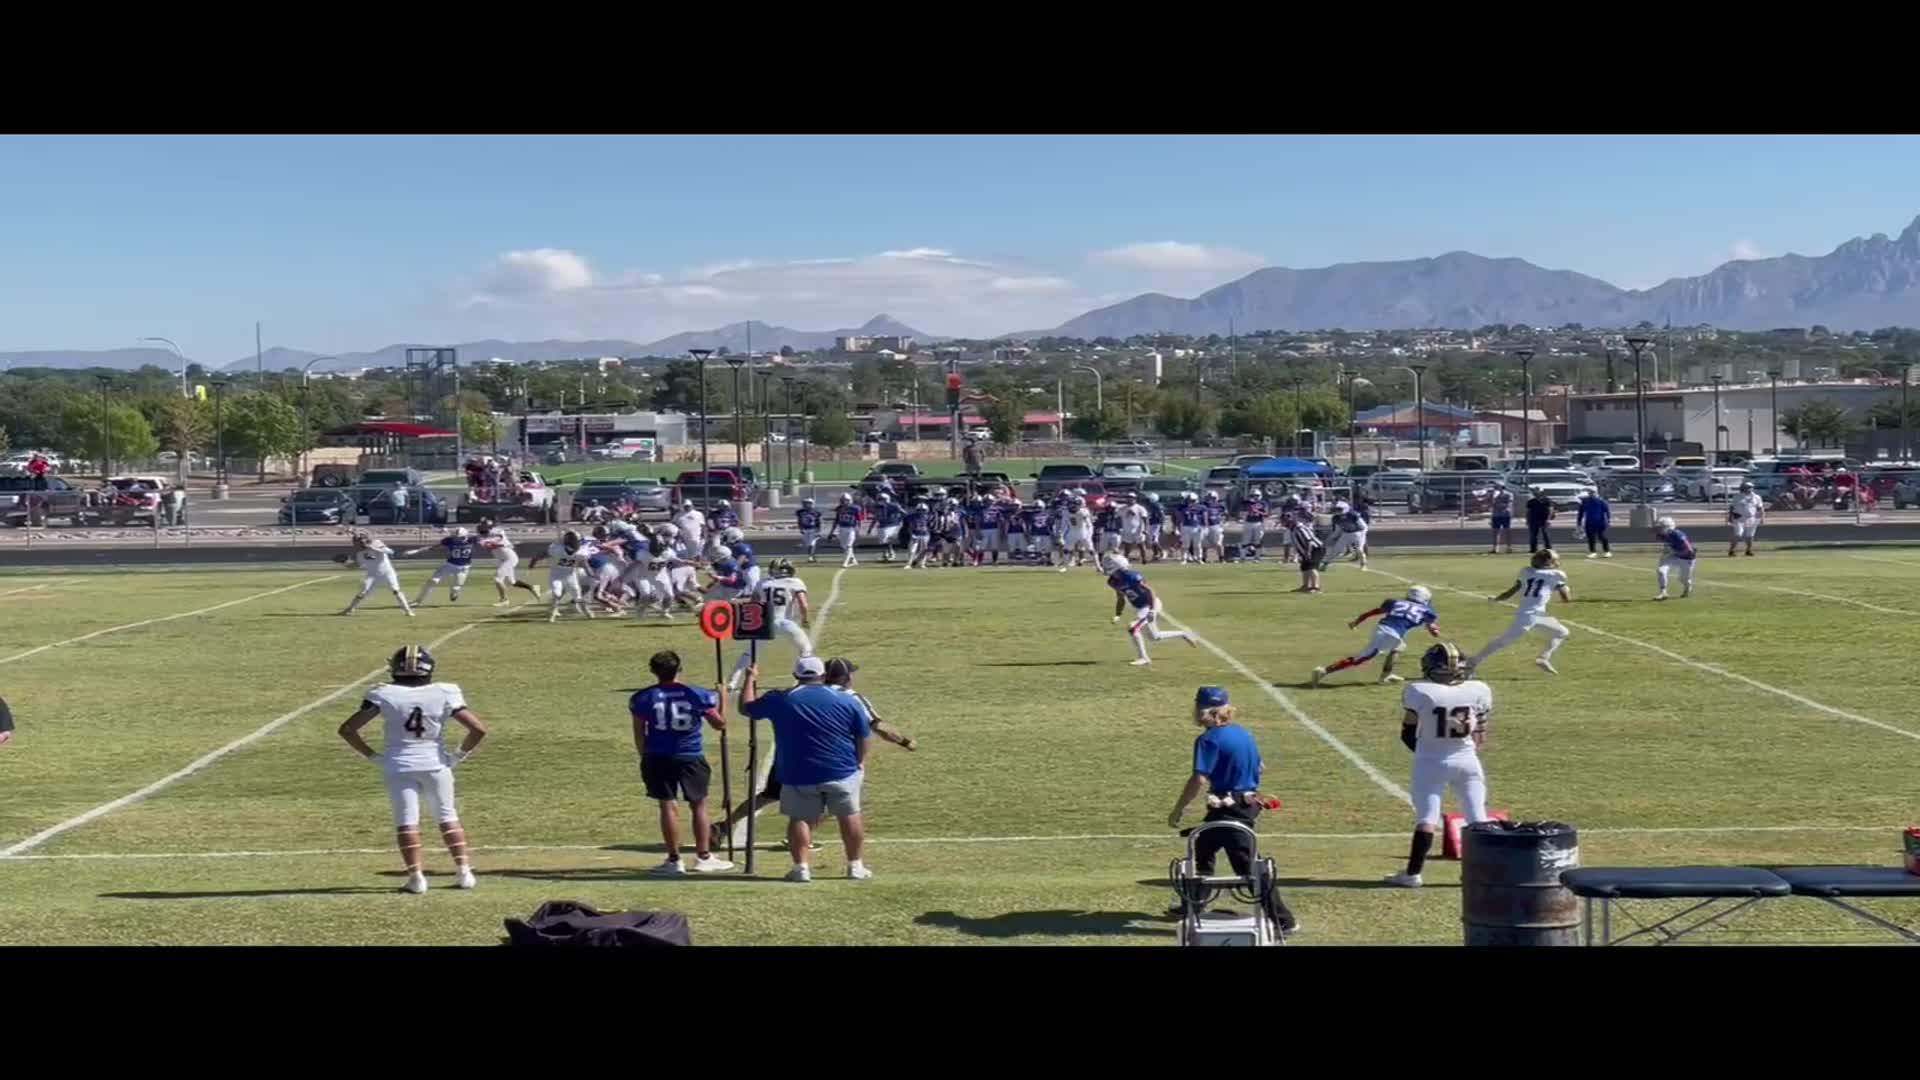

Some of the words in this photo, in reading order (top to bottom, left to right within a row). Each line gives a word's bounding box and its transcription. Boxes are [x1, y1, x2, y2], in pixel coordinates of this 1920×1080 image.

[764, 588, 787, 605] 15
[1524, 577, 1544, 597] 11
[741, 603, 763, 631] 3
[1390, 600, 1427, 624] 25
[404, 706, 425, 738] 4
[653, 702, 692, 730] 16
[1432, 706, 1471, 738] 13
